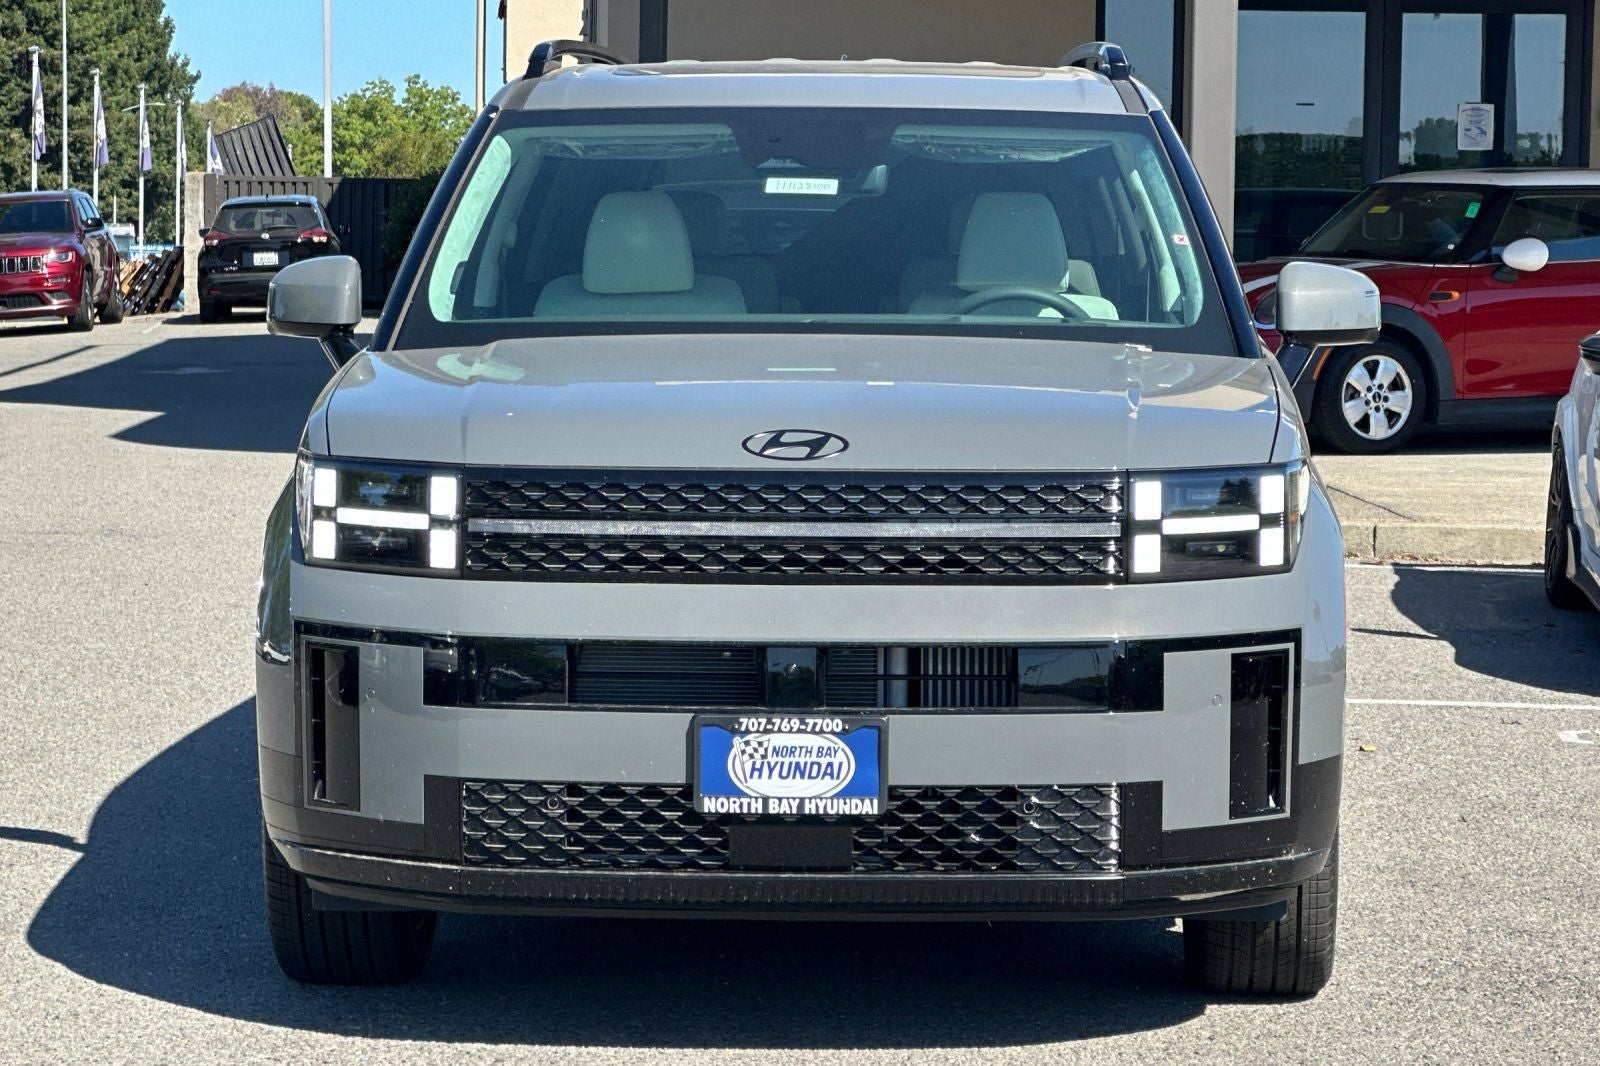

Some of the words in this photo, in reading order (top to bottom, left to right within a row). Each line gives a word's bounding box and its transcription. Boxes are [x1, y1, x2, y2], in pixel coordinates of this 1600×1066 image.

[739, 718, 843, 733] 707-769-7700
[771, 745, 813, 759] NORTH
[815, 745, 841, 759] BAY
[749, 761, 843, 781] HYUNDAI
[703, 797, 763, 814] NORTH
[768, 797, 800, 814] BAY
[804, 798, 879, 815] HYUNDAI
